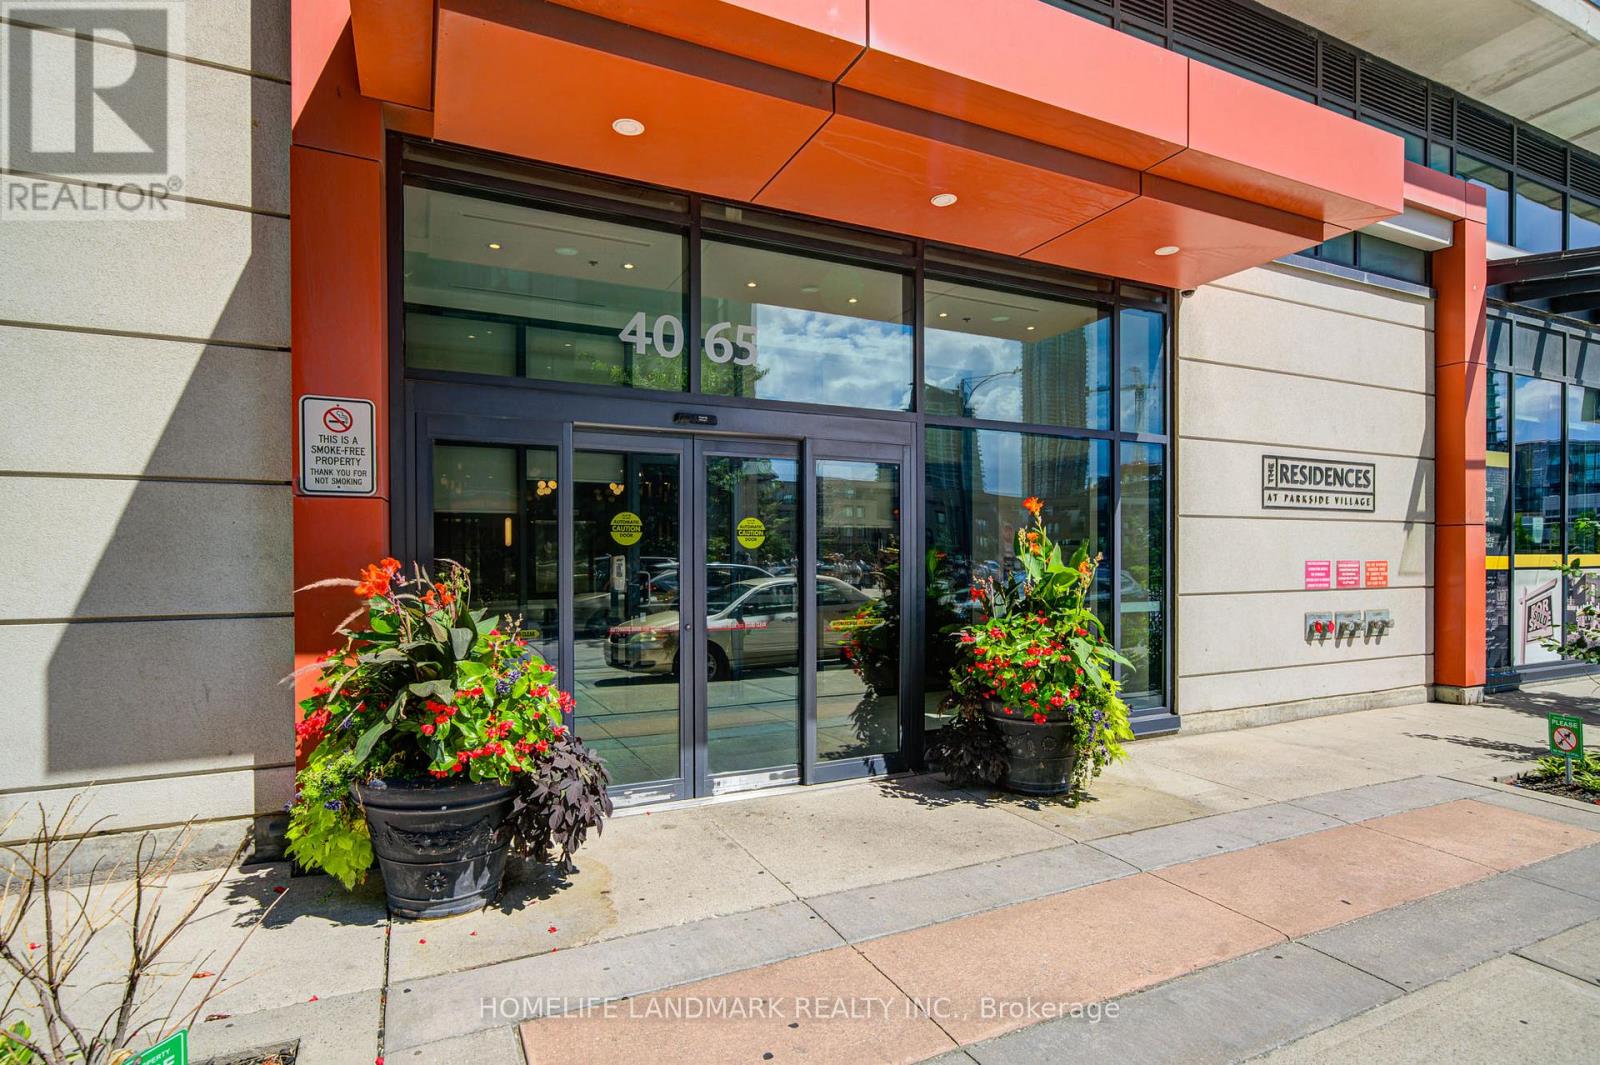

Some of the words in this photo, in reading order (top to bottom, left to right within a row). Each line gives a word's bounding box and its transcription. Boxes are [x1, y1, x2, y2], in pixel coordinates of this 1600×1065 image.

[318, 434, 338, 444] THIS
[341, 435, 350, 445] IS
[352, 436, 359, 445] A
[311, 445, 366, 456] SMOKE-FREE
[315, 456, 362, 466] PROPERTY
[310, 467, 334, 476] THANK
[336, 468, 351, 477] YOU
[353, 469, 367, 477] FOR
[1267, 462, 1275, 484] THE
[1279, 463, 1371, 488] RESIDENCES
[314, 477, 329, 485] NOT
[331, 477, 363, 486] SMOKING
[1266, 493, 1278, 503] AT
[1283, 493, 1330, 505] PARKSIDE
[1334, 495, 1371, 507] VILLAGE
[1533, 610, 1548, 626] SOLD
[1551, 718, 1580, 729] PLEASE
